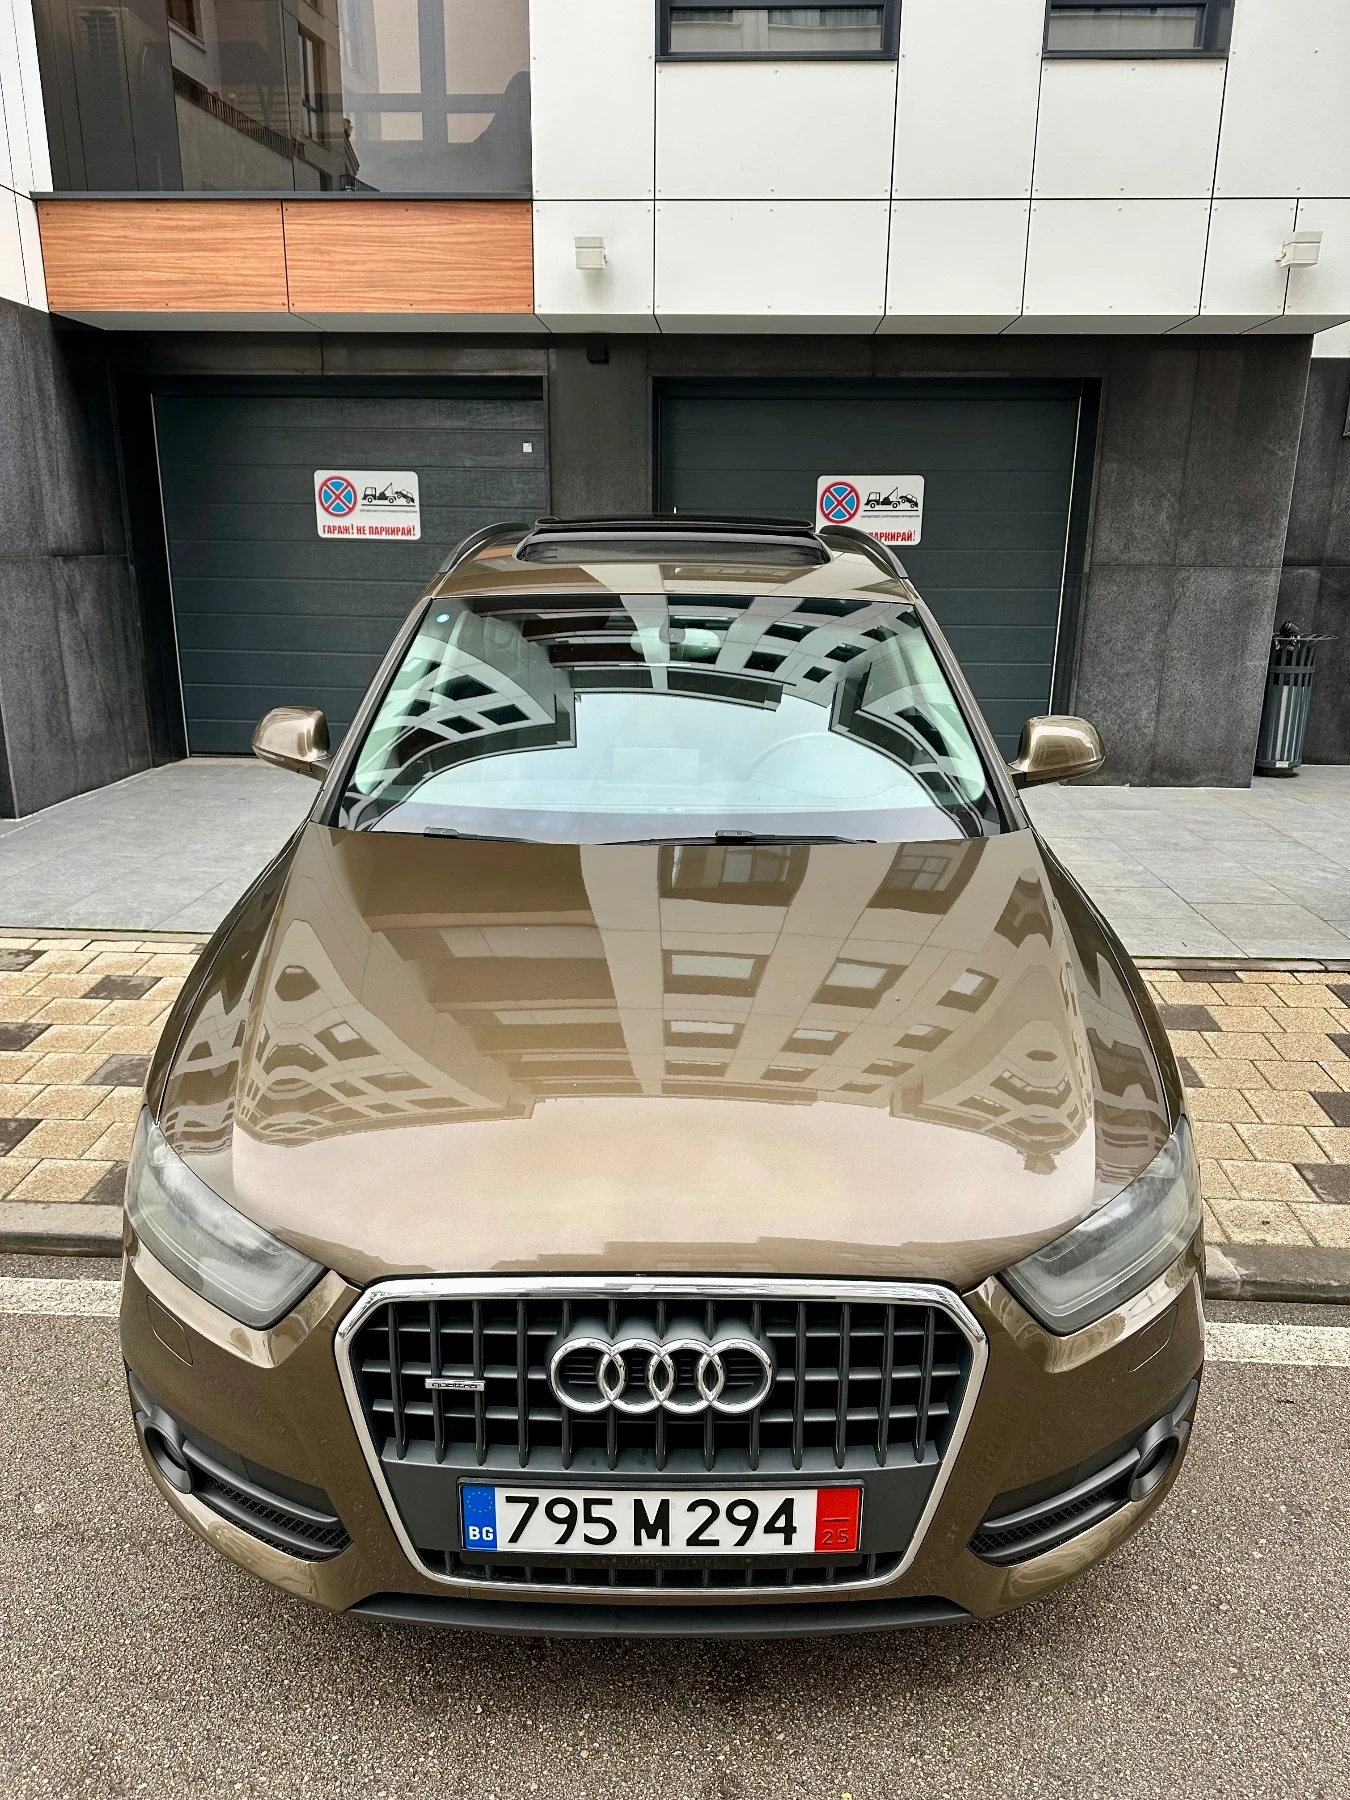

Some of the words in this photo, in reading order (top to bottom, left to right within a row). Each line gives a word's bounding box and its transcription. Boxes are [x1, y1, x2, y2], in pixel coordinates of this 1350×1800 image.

[322, 524, 354, 535] ГАРАЖ!
[356, 525, 367, 535] НЕ
[368, 525, 416, 536] ПАРКИРАЙ!
[468, 1525, 494, 1541] BG
[505, 1495, 618, 1546] 795
[633, 1498, 670, 1546] M
[686, 1497, 797, 1547] 294
[821, 1527, 849, 1545] 25
